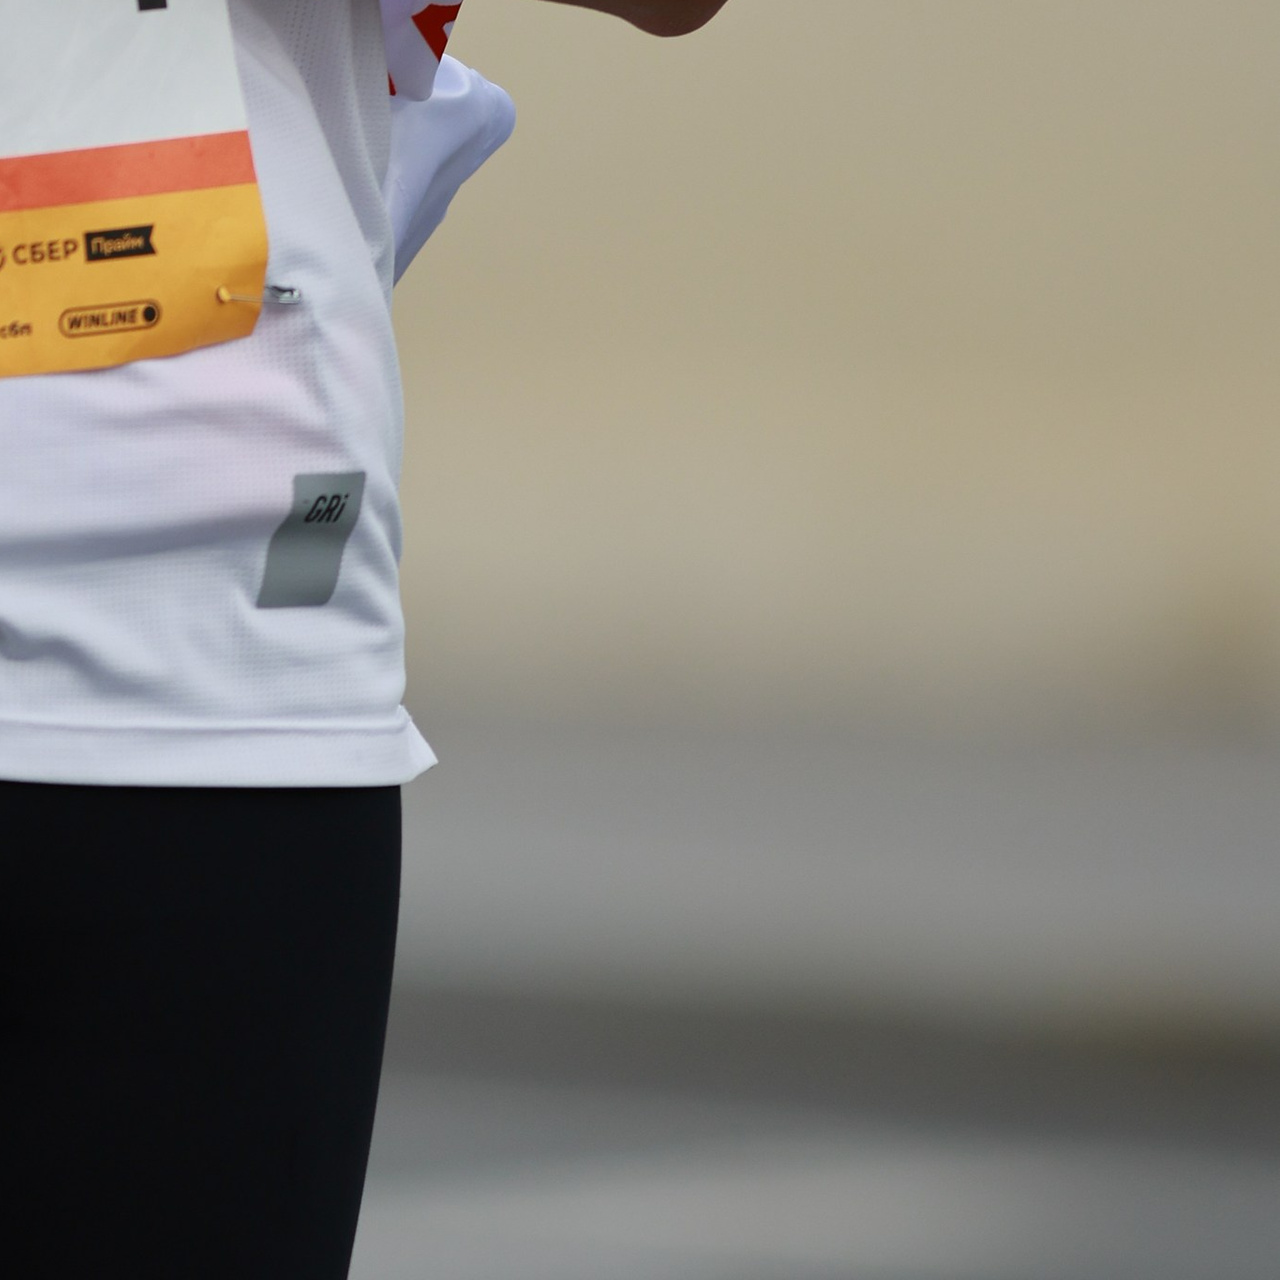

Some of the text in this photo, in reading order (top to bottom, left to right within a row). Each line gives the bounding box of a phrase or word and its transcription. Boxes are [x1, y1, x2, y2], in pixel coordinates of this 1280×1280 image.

[12, 234, 145, 265] СБЕР Прайм
[0, 321, 32, 340] сбп
[67, 307, 138, 331] WINLINE
[304, 493, 350, 523] GRi
